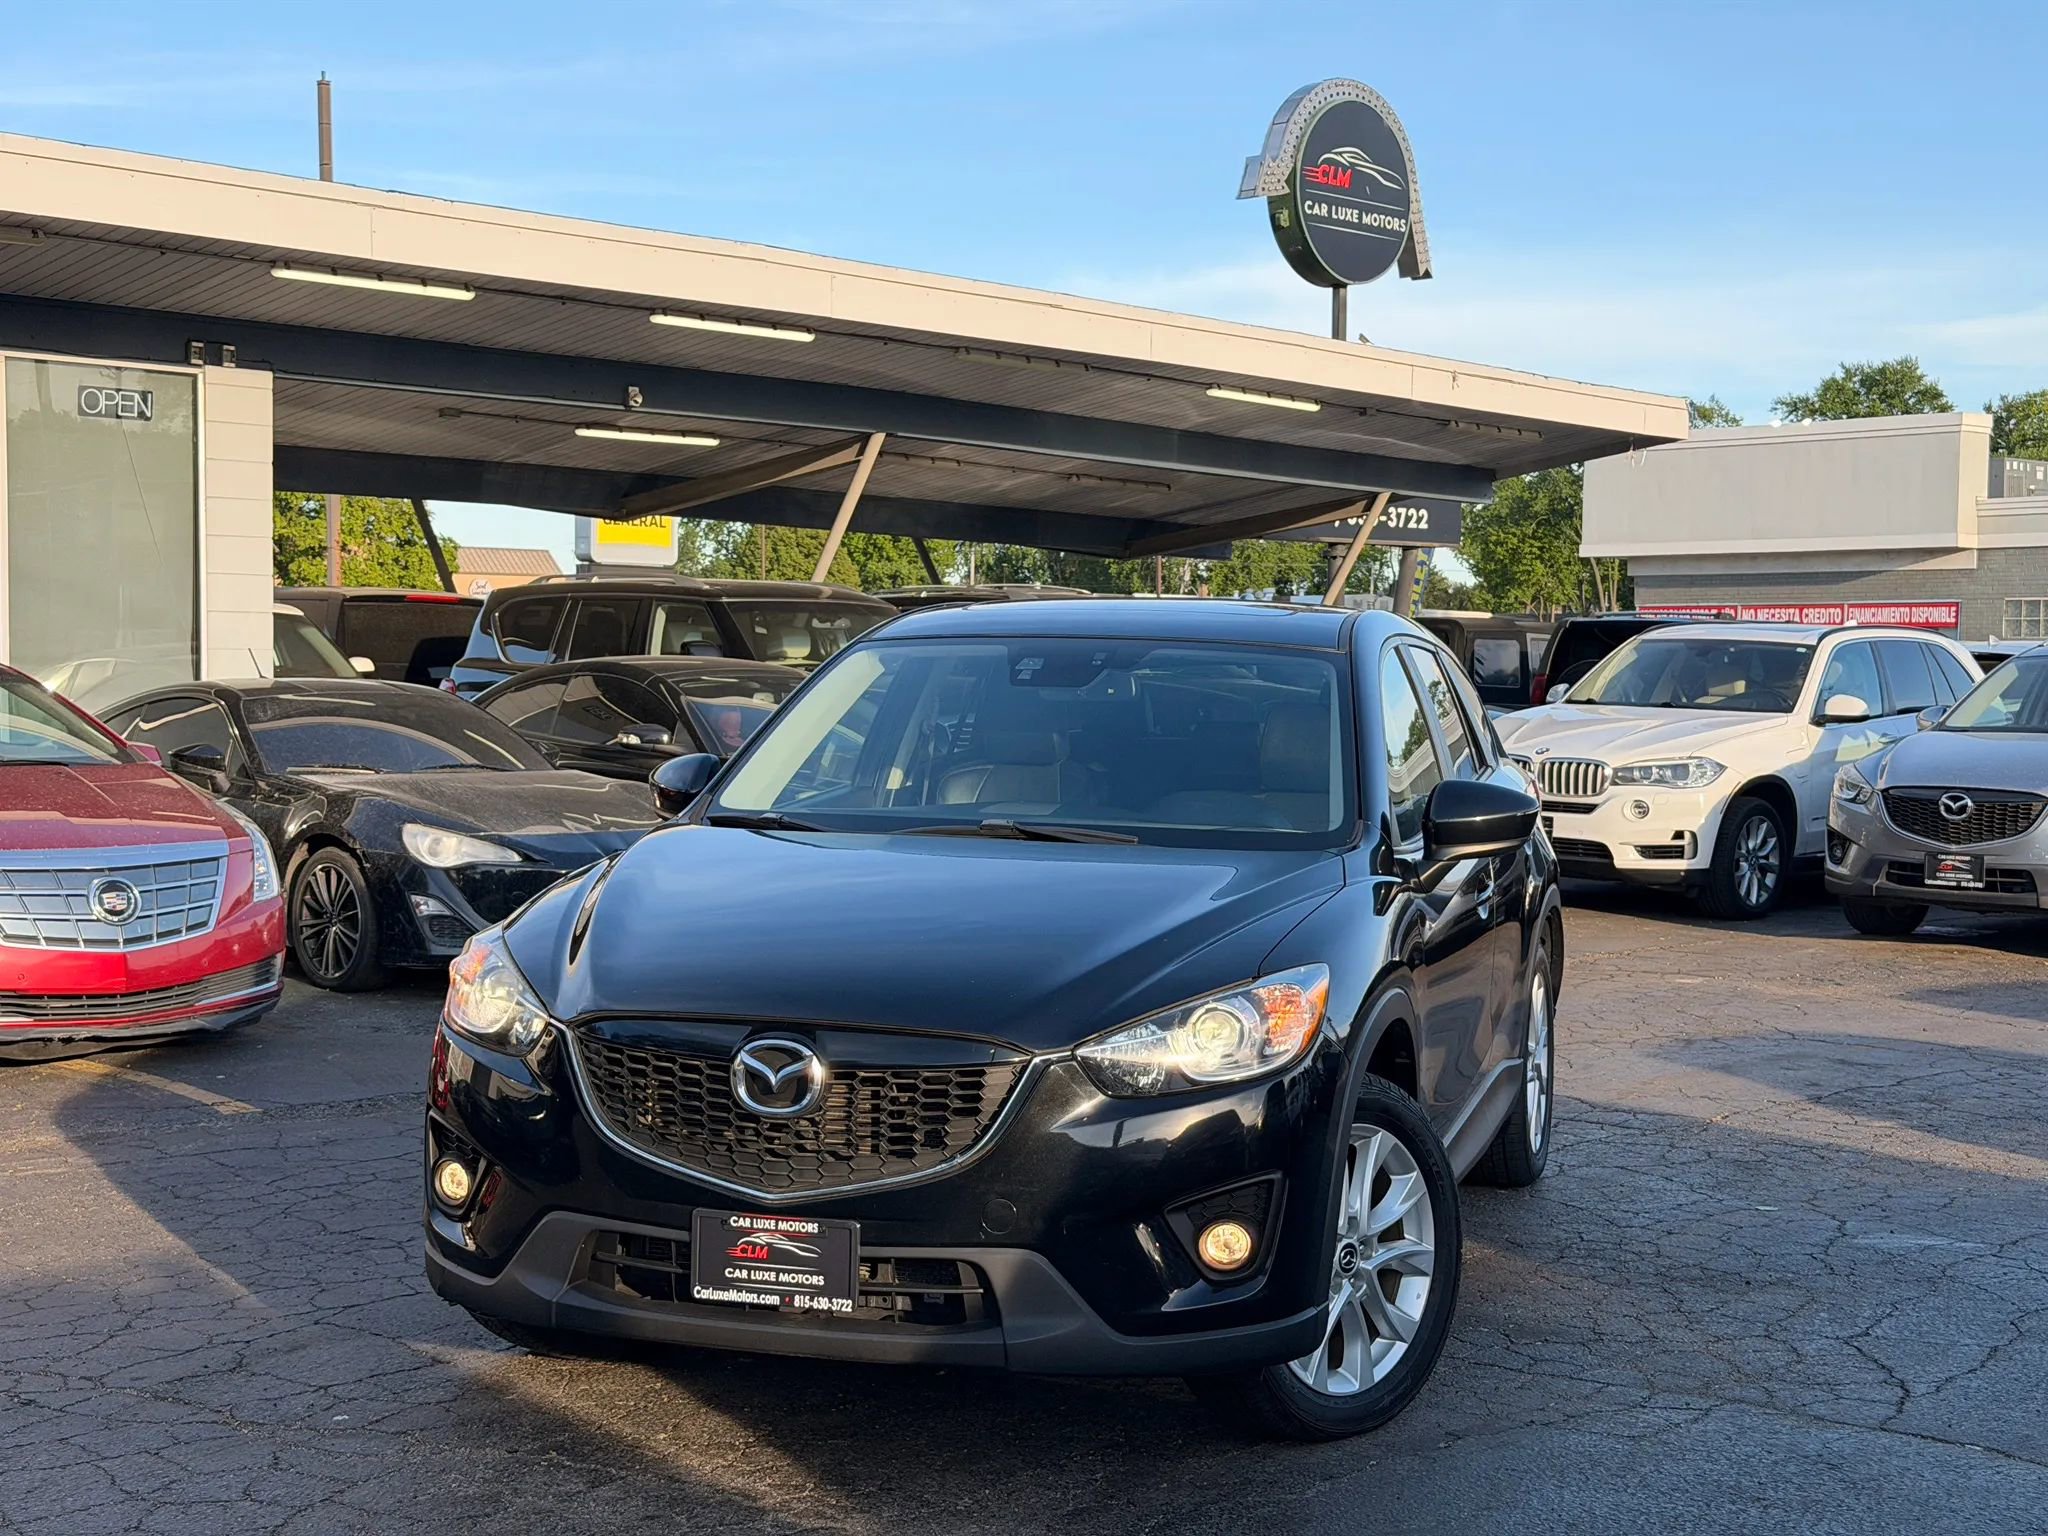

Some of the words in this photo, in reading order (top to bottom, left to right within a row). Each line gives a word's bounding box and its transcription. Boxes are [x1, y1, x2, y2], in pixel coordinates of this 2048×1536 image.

[1318, 164, 1352, 189] CLM
[1304, 200, 1328, 217] CAR
[1332, 205, 1360, 223] LUXE
[1362, 211, 1407, 232] MOTORS
[81, 388, 152, 418] OPEN
[1742, 608, 1756, 621] NO
[1757, 608, 1801, 622] NECESITA
[1802, 607, 1843, 624] CREDITO
[1848, 606, 1910, 624] FINANCIAMIENTO
[1911, 605, 1957, 623] DISPONIBLE
[730, 1216, 751, 1227] CAR
[753, 1218, 776, 1230] LUXE
[777, 1221, 819, 1234] MOTORS
[736, 1244, 769, 1260] CLM
[724, 1268, 749, 1279] CAR
[750, 1270, 777, 1281] LUXE
[778, 1272, 825, 1286] MOTORS
[693, 1285, 780, 1306] CarLuxeMotors.com
[793, 1294, 853, 1312] 815-630-3722
